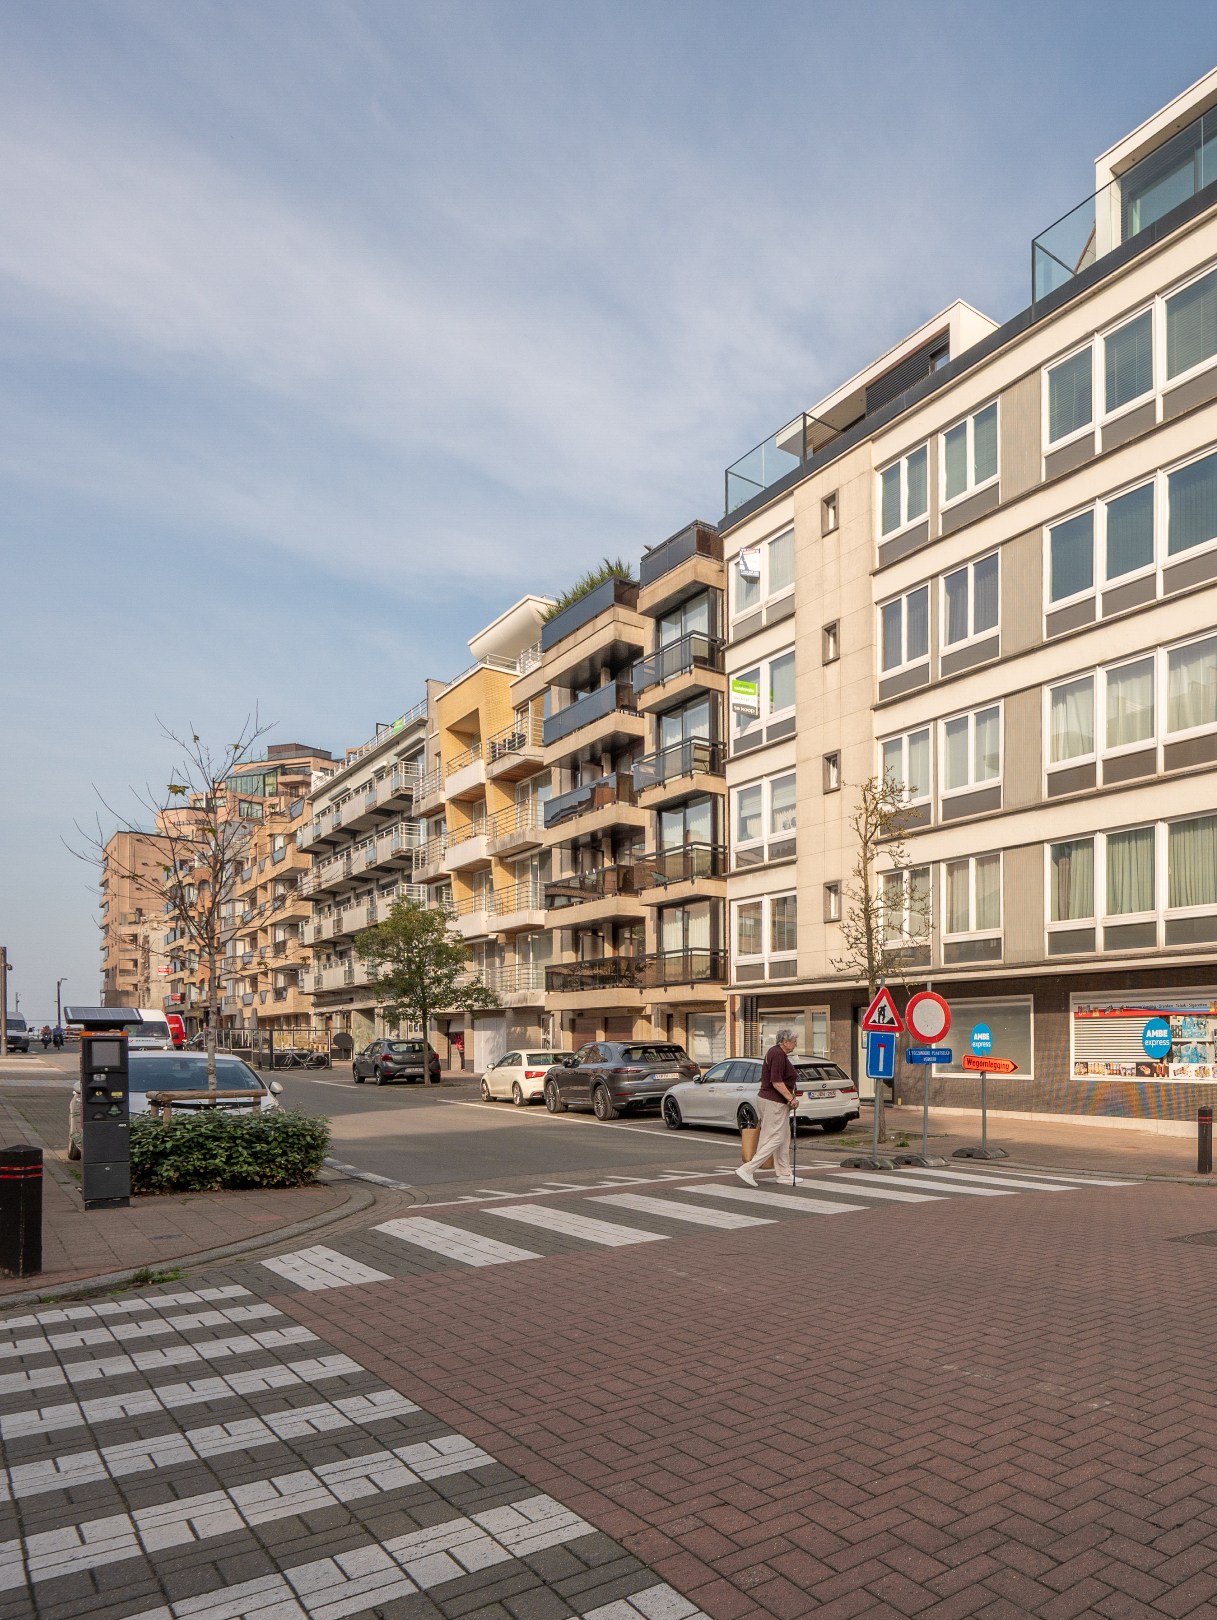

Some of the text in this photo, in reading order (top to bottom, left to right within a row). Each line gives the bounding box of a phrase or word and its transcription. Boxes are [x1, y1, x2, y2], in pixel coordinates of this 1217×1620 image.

[1146, 1029, 1168, 1037] AMBE
[972, 1041, 991, 1049] express
[1144, 1039, 1170, 1048] express
[966, 1057, 1010, 1071] Wegomlegging
